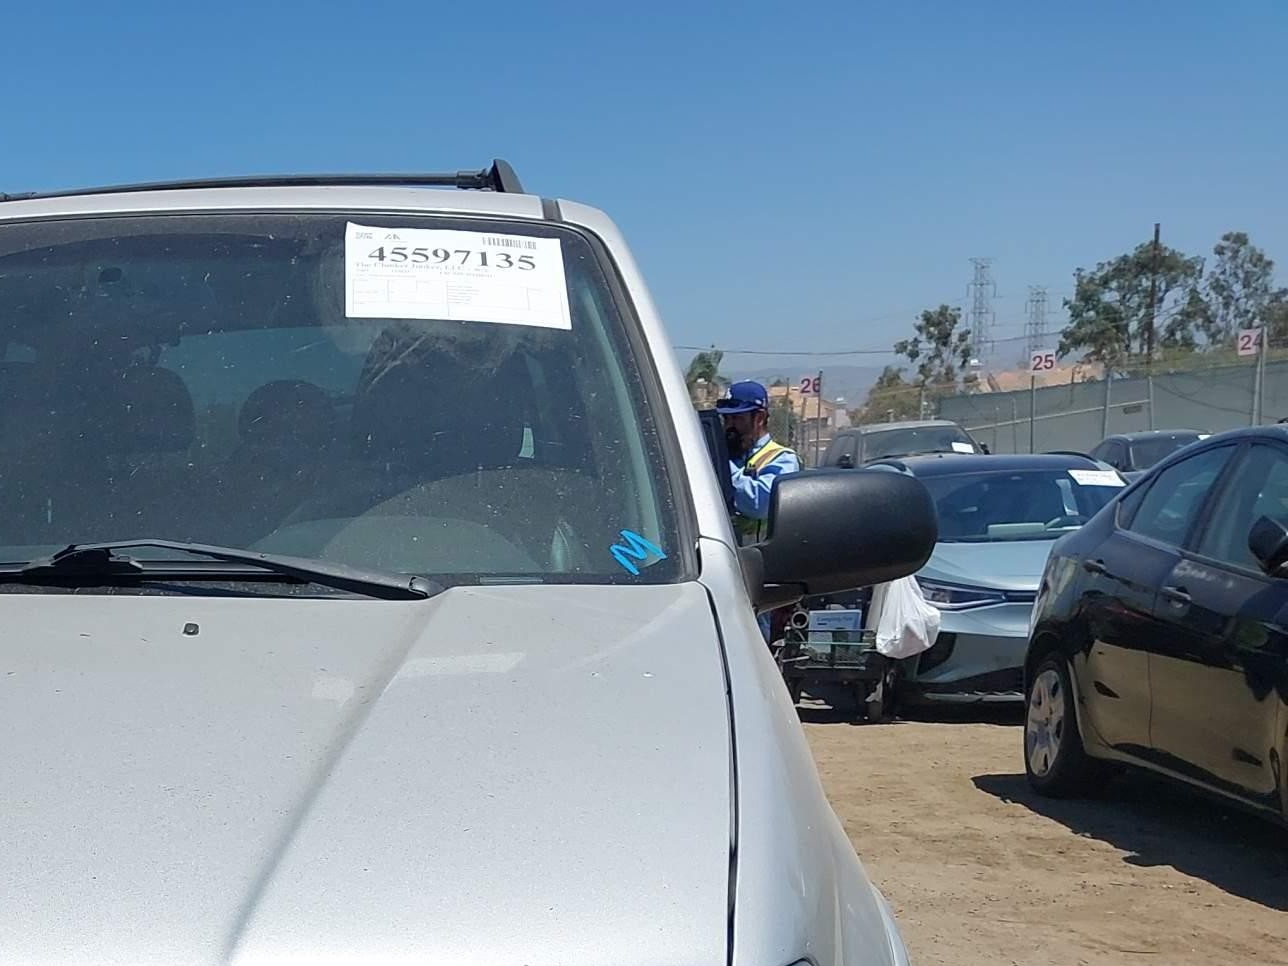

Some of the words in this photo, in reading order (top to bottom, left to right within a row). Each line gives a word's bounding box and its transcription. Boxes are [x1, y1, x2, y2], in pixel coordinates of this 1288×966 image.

[368, 246, 536, 271] 45597135
[1032, 353, 1054, 371] 25
[799, 377, 821, 394] 26
